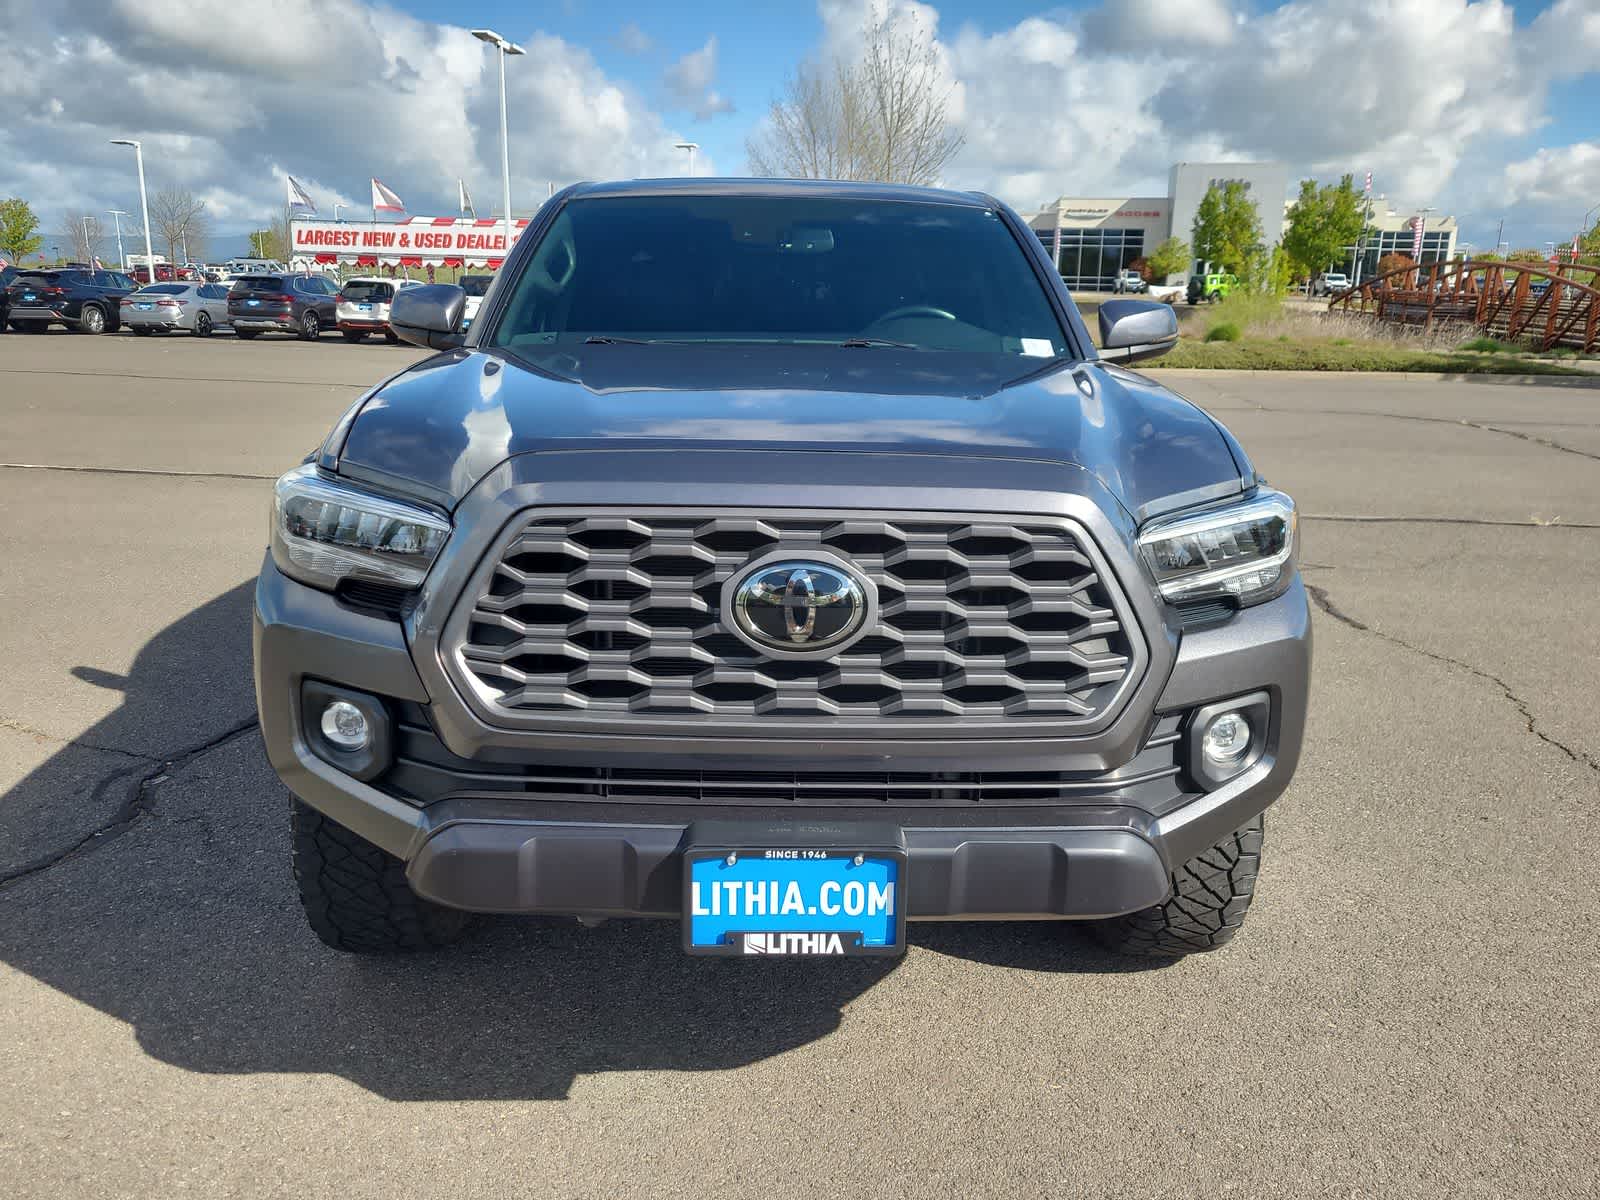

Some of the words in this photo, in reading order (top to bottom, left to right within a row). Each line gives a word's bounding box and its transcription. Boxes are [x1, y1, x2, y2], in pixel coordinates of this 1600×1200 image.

[297, 230, 359, 246] LARGEST
[362, 232, 397, 247] NEW
[399, 233, 410, 248] &
[414, 233, 452, 249] USED
[765, 850, 798, 859] SINCE
[801, 850, 827, 859] 1946
[692, 881, 895, 916] LITHIA.COM
[768, 933, 844, 954] LITHIA
